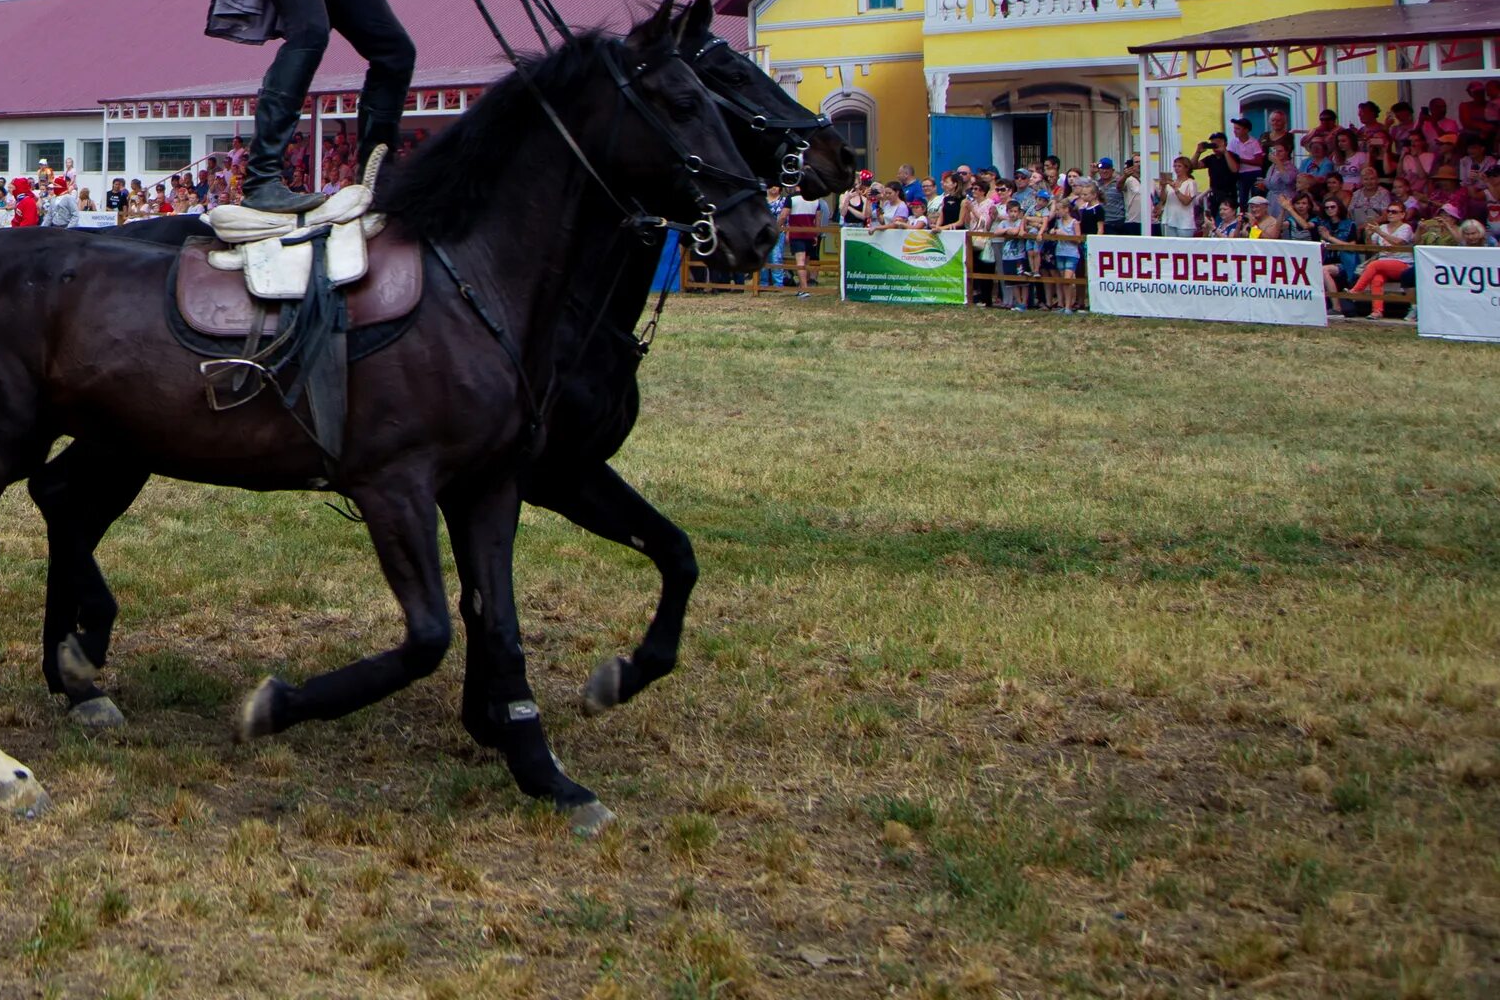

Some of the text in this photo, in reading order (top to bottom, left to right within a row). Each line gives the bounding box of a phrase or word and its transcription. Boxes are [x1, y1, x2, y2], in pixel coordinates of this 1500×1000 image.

[1098, 251, 1311, 286] РОСГОССТРАХ
[1099, 281, 1312, 301] ПОД КРЫЛОМ СИЛЬНОЙ КОМПАНИИ
